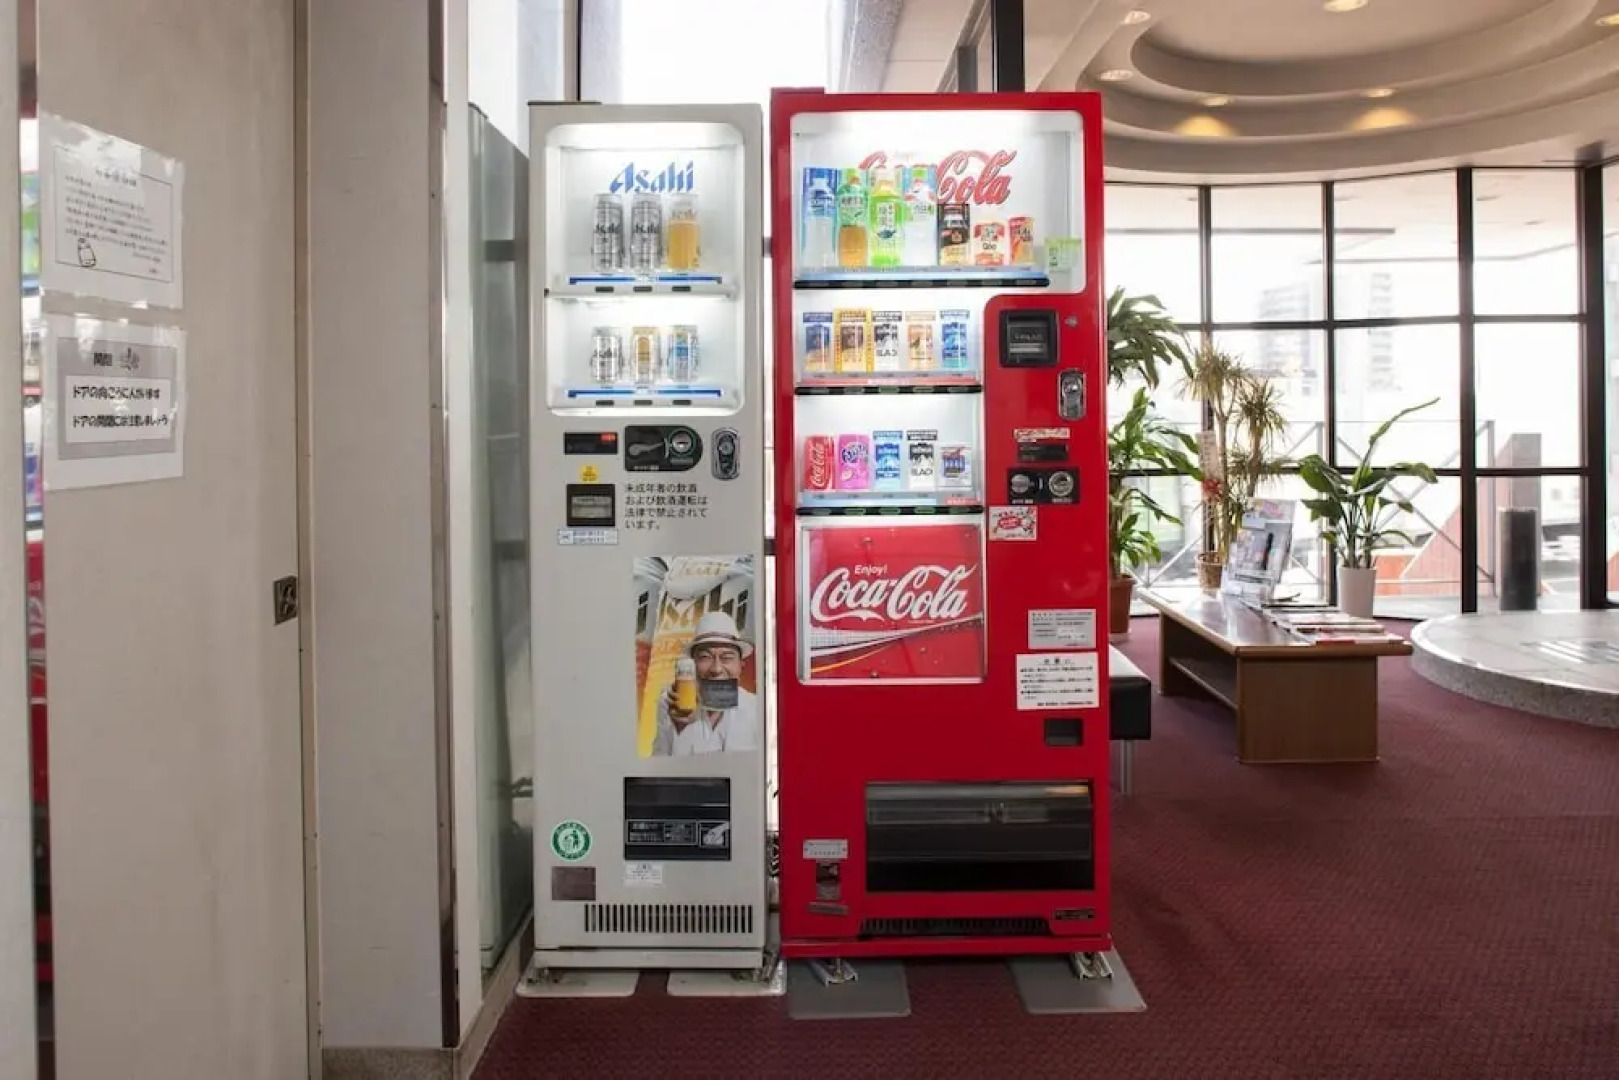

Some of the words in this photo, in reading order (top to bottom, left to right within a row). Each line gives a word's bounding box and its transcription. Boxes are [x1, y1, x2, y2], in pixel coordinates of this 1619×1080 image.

[609, 160, 694, 194] Asahi
[624, 483, 697, 493] 未成年者の飲酒
[624, 495, 709, 506] および飲酒運転は
[624, 507, 711, 518] 法律で禁止されて
[624, 519, 661, 530] います。
[854, 564, 888, 576] Enjoy!
[810, 562, 978, 623] Coca-Cola
